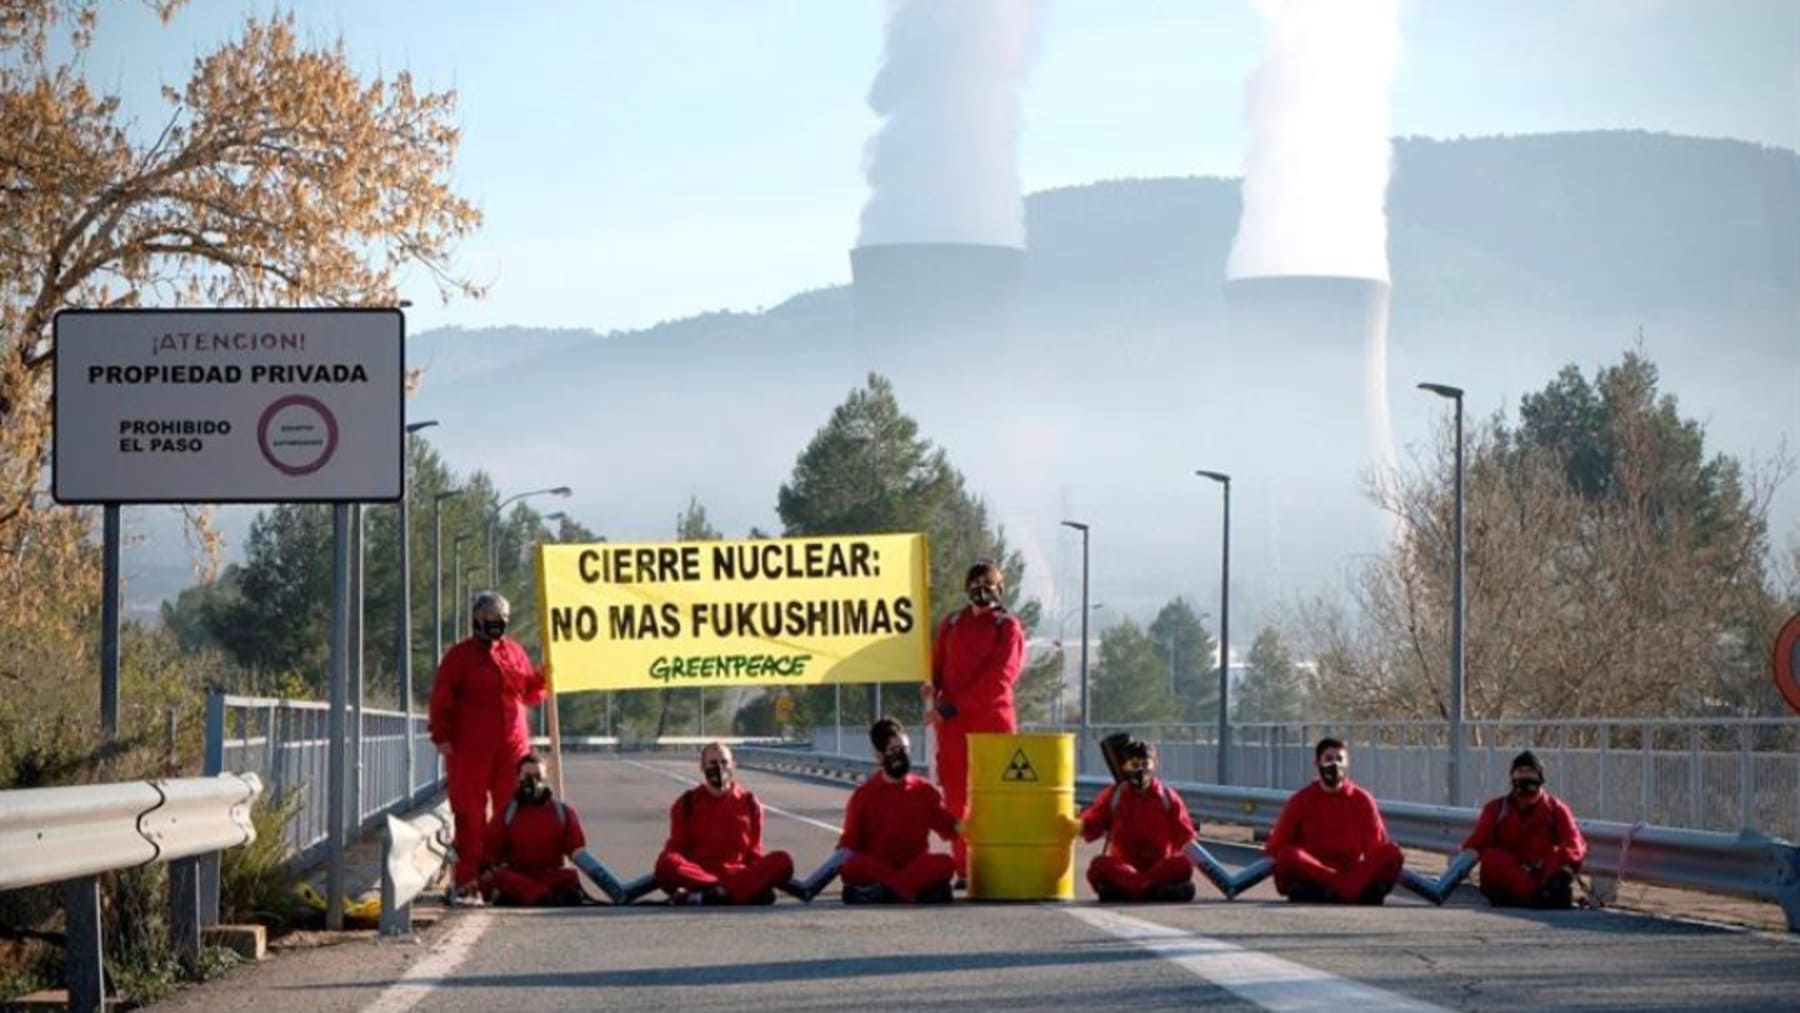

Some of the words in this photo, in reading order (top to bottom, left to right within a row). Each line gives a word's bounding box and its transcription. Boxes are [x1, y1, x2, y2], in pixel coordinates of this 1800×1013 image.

[88, 365, 242, 384] PROPIEDAD
[251, 364, 368, 383] PRIVADA
[120, 421, 231, 434] PROHIBIDO
[120, 439, 143, 452] EL
[150, 439, 203, 452] PASO
[578, 547, 700, 583] CIERRE
[713, 542, 881, 580] NUCLEAR:
[551, 605, 598, 642] NO
[609, 603, 681, 639] MAS
[692, 597, 914, 637] FUKUSHIMAS
[649, 654, 812, 683] GREENPEACE
